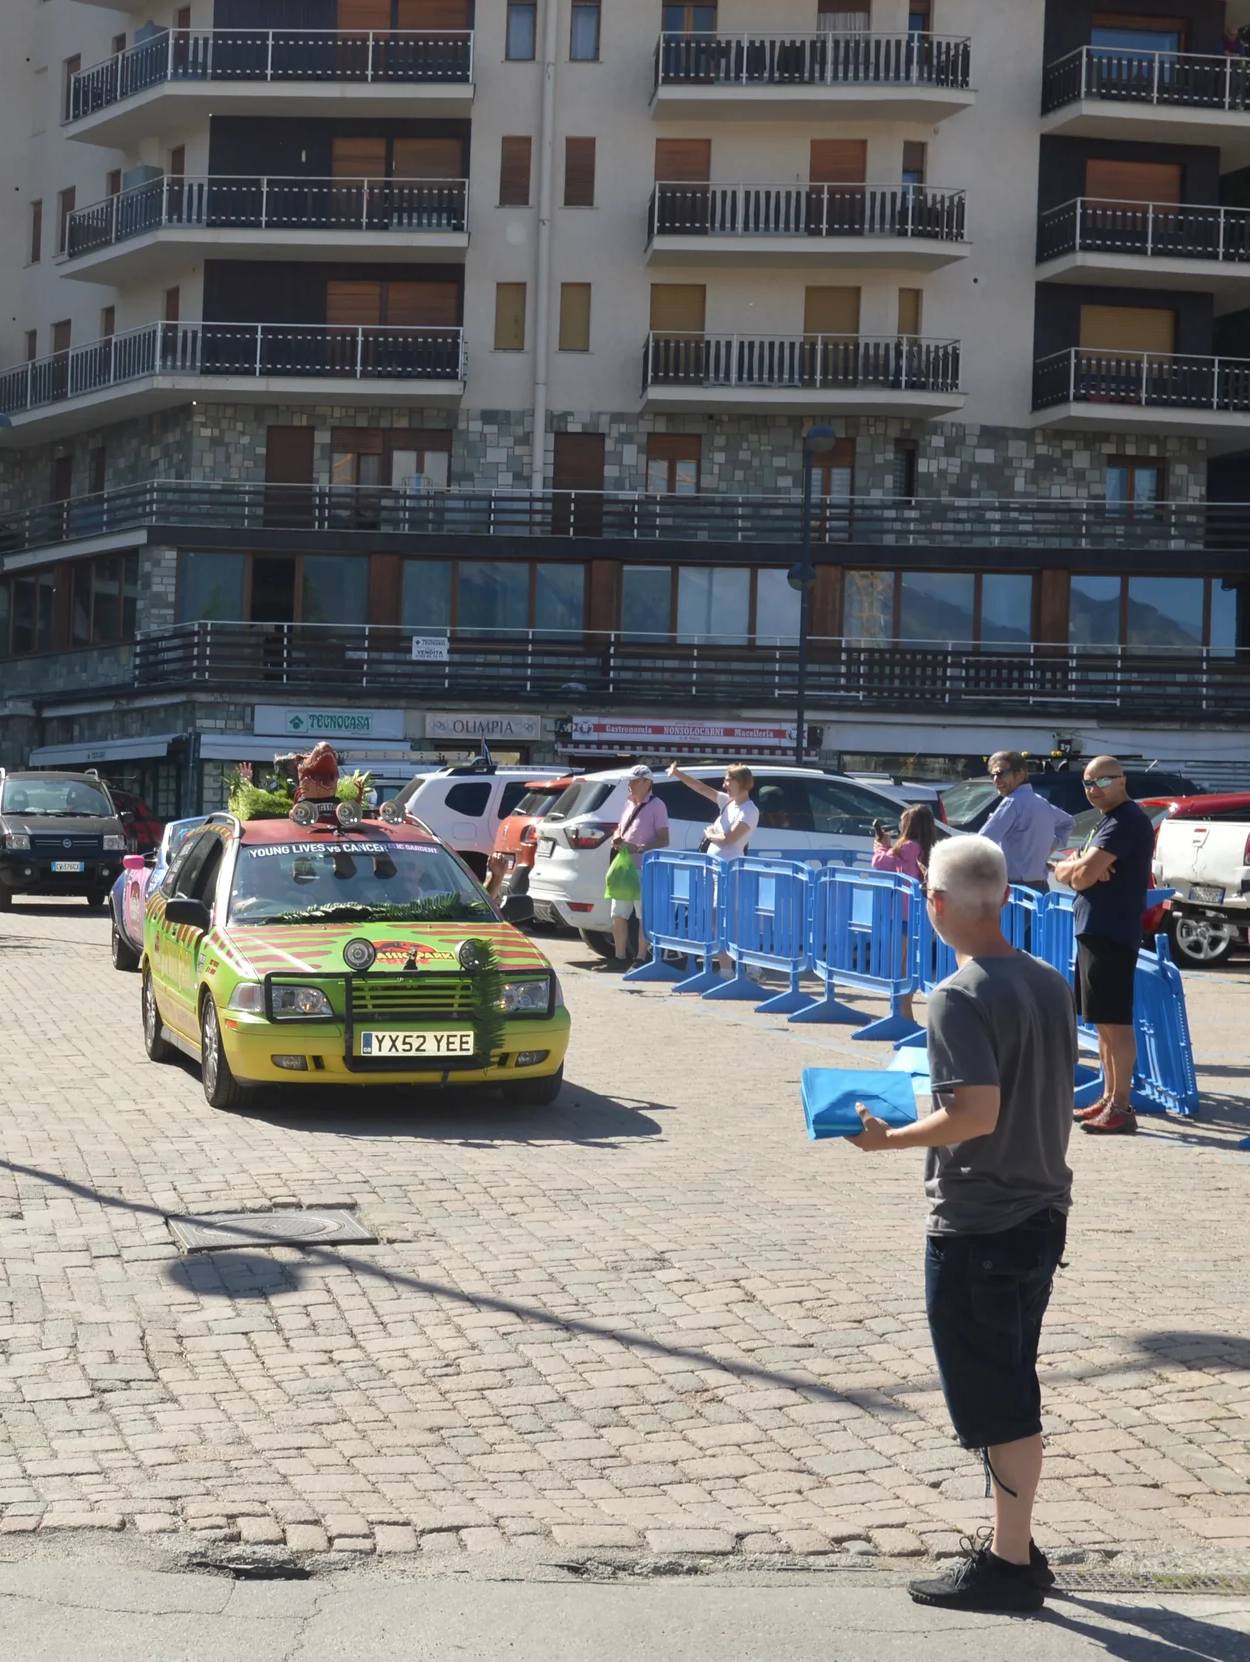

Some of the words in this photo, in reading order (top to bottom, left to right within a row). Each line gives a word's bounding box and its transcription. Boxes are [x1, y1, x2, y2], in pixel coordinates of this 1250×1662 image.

[309, 714, 370, 731] TECNOCASA
[452, 719, 514, 734] OLIMPIA
[605, 724, 653, 734] Gastronomia
[663, 725, 724, 737] NONSOLOCARNI
[734, 728, 774, 738] Macelleria
[1060, 743, 1071, 753] 17
[249, 845, 292, 858] YOUNG
[292, 843, 326, 854] LIVES
[342, 843, 389, 853] CANCER
[405, 844, 439, 854] SARGENT
[416, 951, 453, 960] PARK
[374, 1034, 427, 1053] YX52
[433, 1034, 471, 1052] YEE
